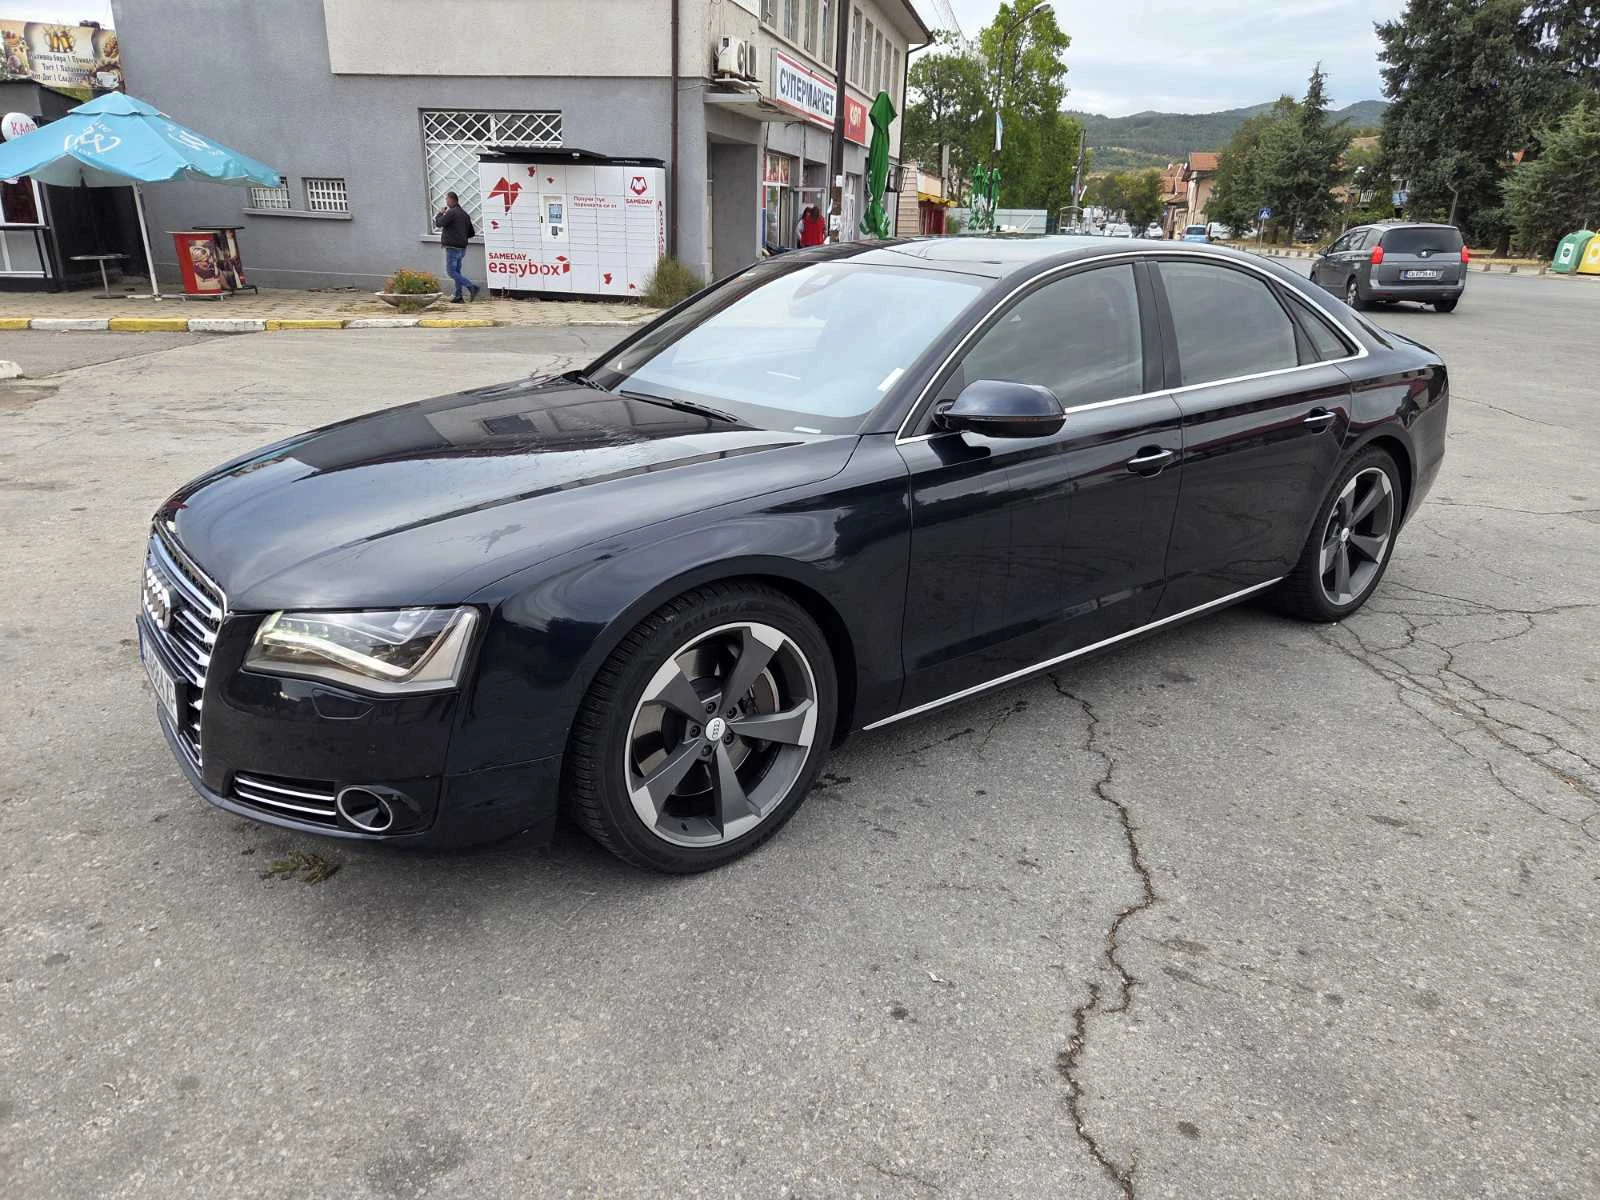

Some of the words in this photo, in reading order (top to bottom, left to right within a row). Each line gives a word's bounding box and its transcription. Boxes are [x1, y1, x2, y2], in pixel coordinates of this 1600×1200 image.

[780, 67, 834, 116] СУПЕРМАРКЕТ
[488, 252, 527, 261] SAMEDAY
[488, 258, 561, 278] easybox
